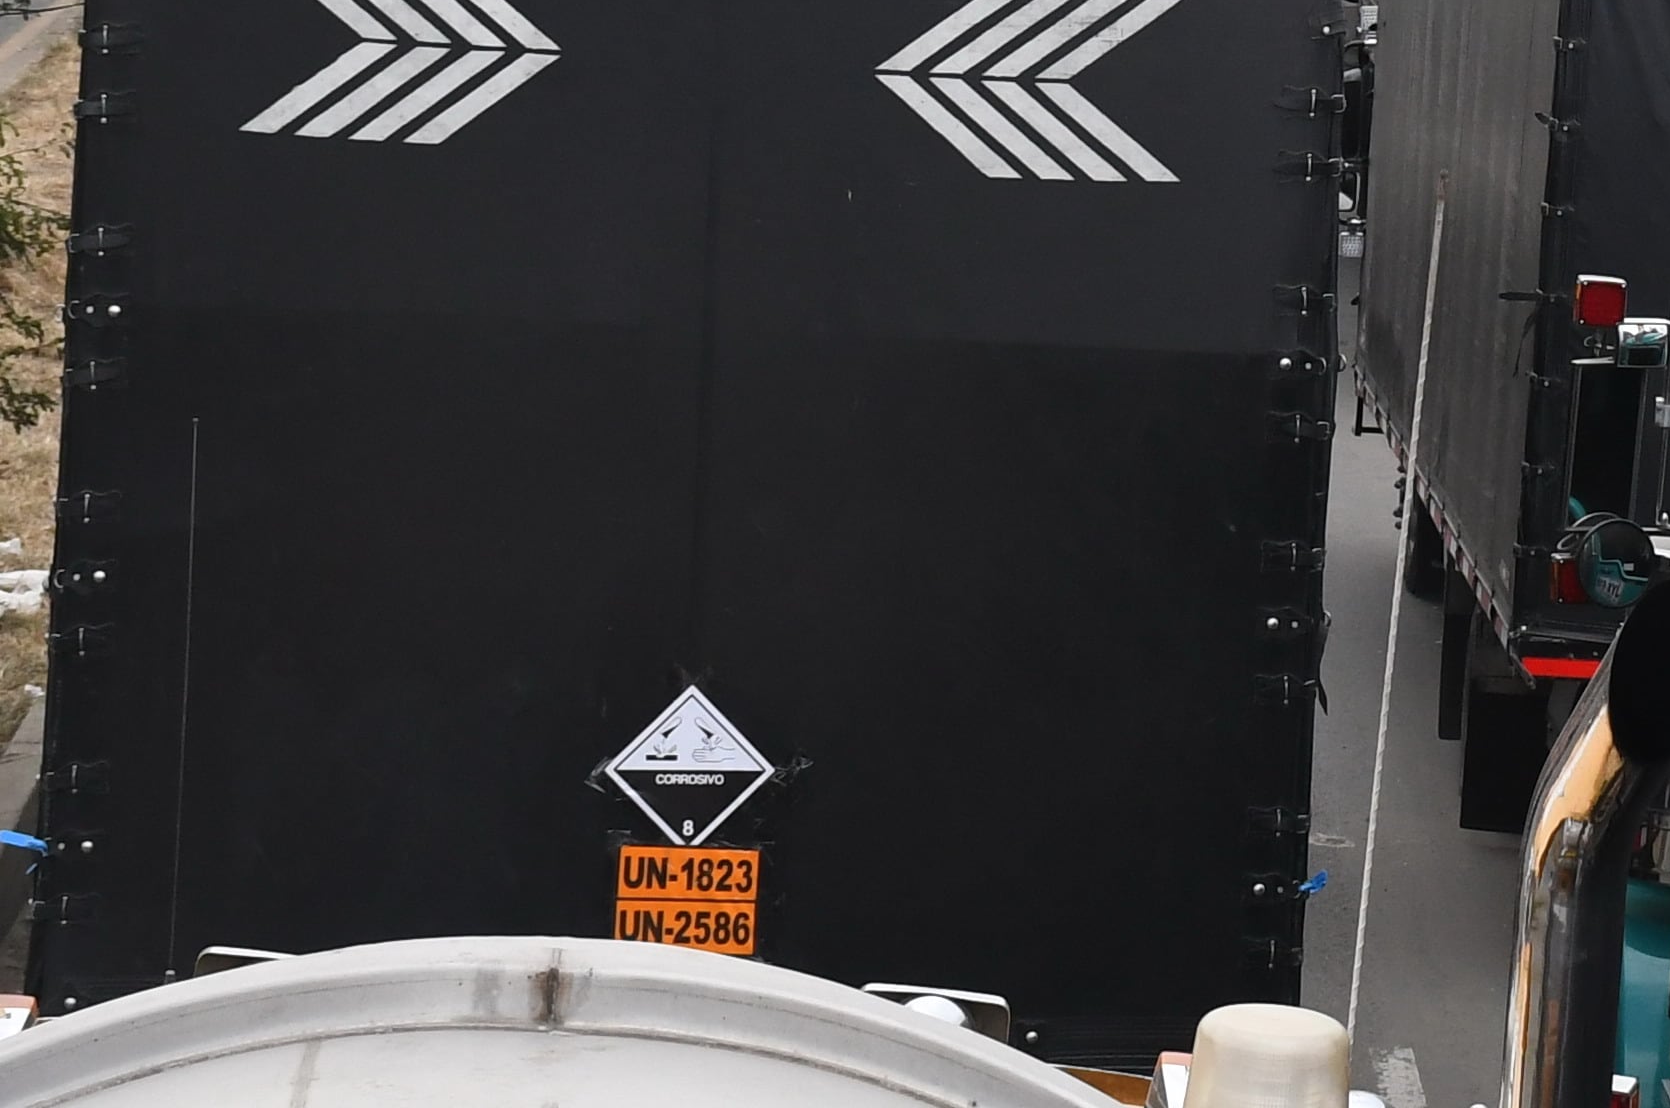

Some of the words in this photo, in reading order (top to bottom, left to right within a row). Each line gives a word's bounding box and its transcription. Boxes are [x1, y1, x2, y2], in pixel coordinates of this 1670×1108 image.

[655, 773, 725, 786] CORROSIVO
[682, 819, 695, 836] 8
[623, 855, 754, 893] UN-1823
[619, 909, 750, 946] UN-2586
